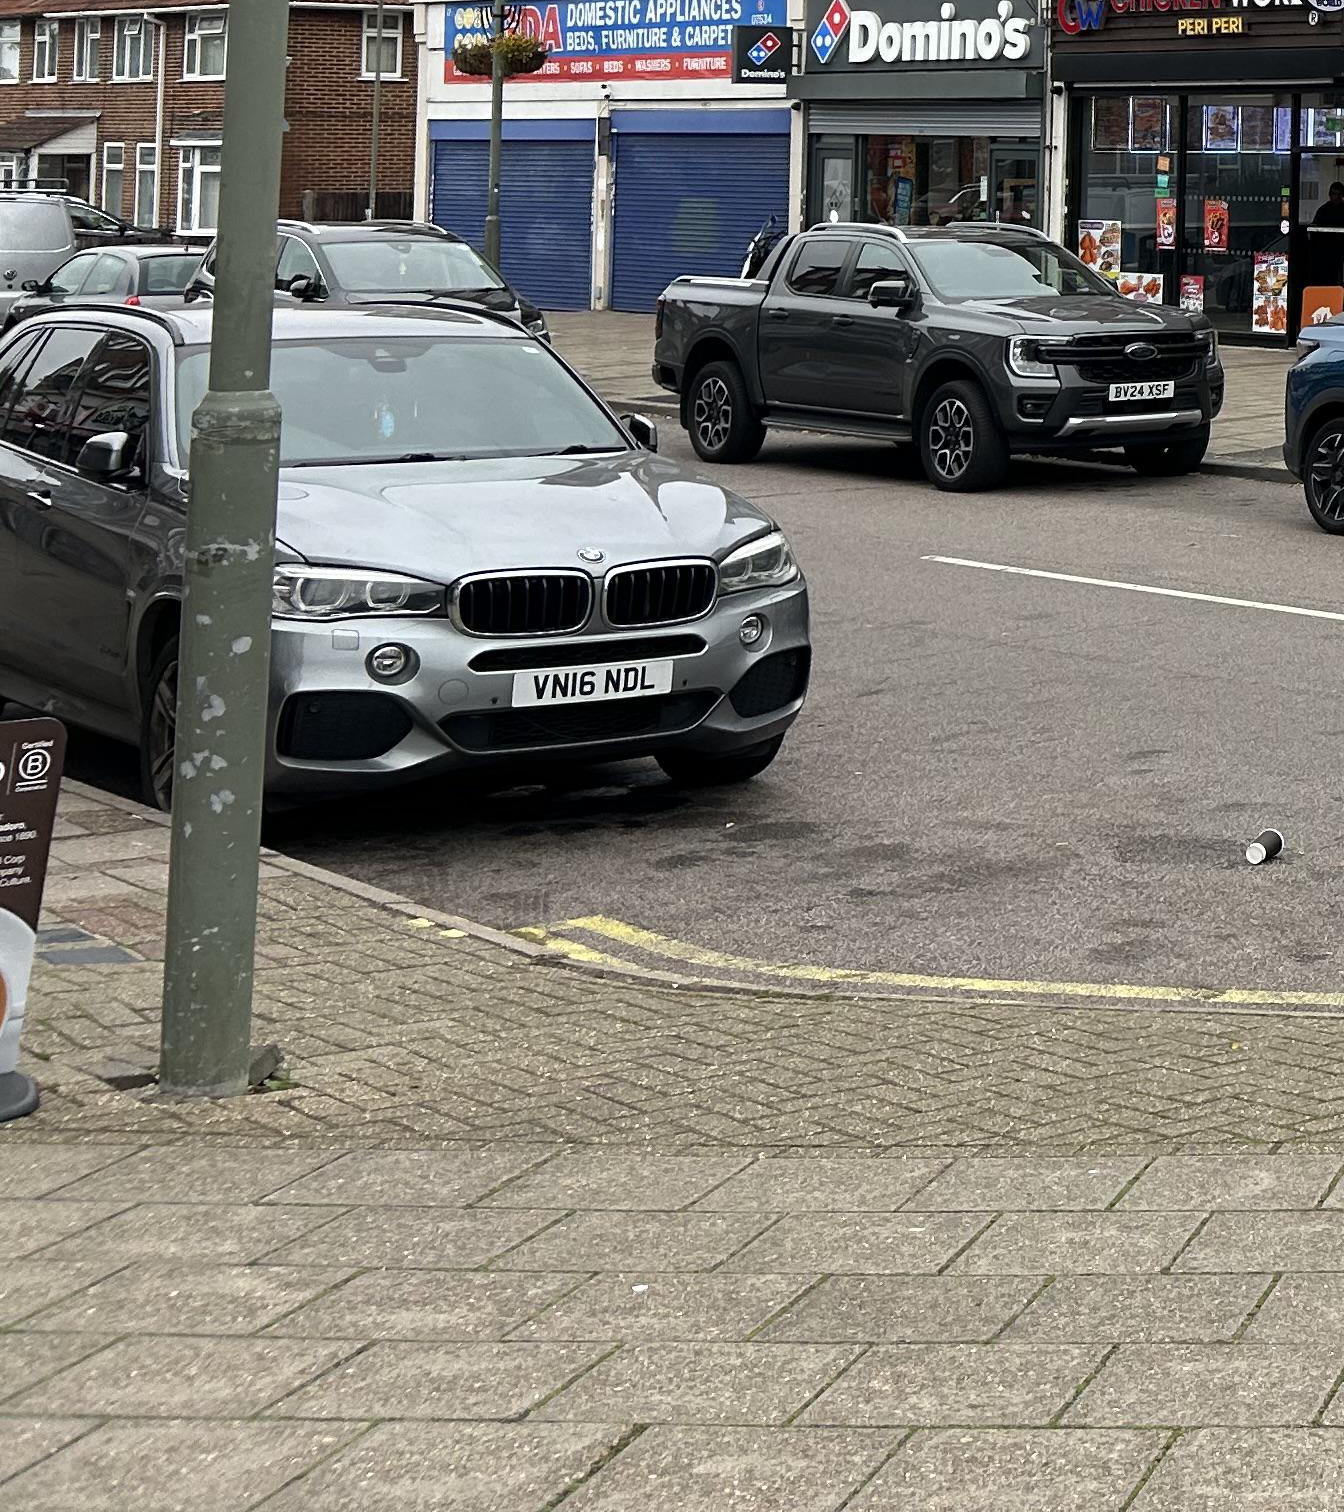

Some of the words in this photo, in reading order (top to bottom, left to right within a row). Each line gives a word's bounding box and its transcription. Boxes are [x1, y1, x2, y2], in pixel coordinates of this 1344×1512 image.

[567, 0, 641, 27] DOMESTIC
[849, 0, 1031, 63] Domino's
[1178, 18, 1208, 35] PERI
[1212, 16, 1243, 34] PERI
[566, 31, 599, 54] BEDS,
[602, 27, 667, 50] FURNITURE
[671, 29, 681, 47] &
[603, 60, 623, 73] BEDS
[741, 68, 786, 78] Domino's
[1114, 385, 1145, 399] BV24
[1148, 383, 1170, 397] XSF
[534, 671, 596, 700] VN16
[604, 665, 655, 694] NDL
[26, 754, 43, 774] B
